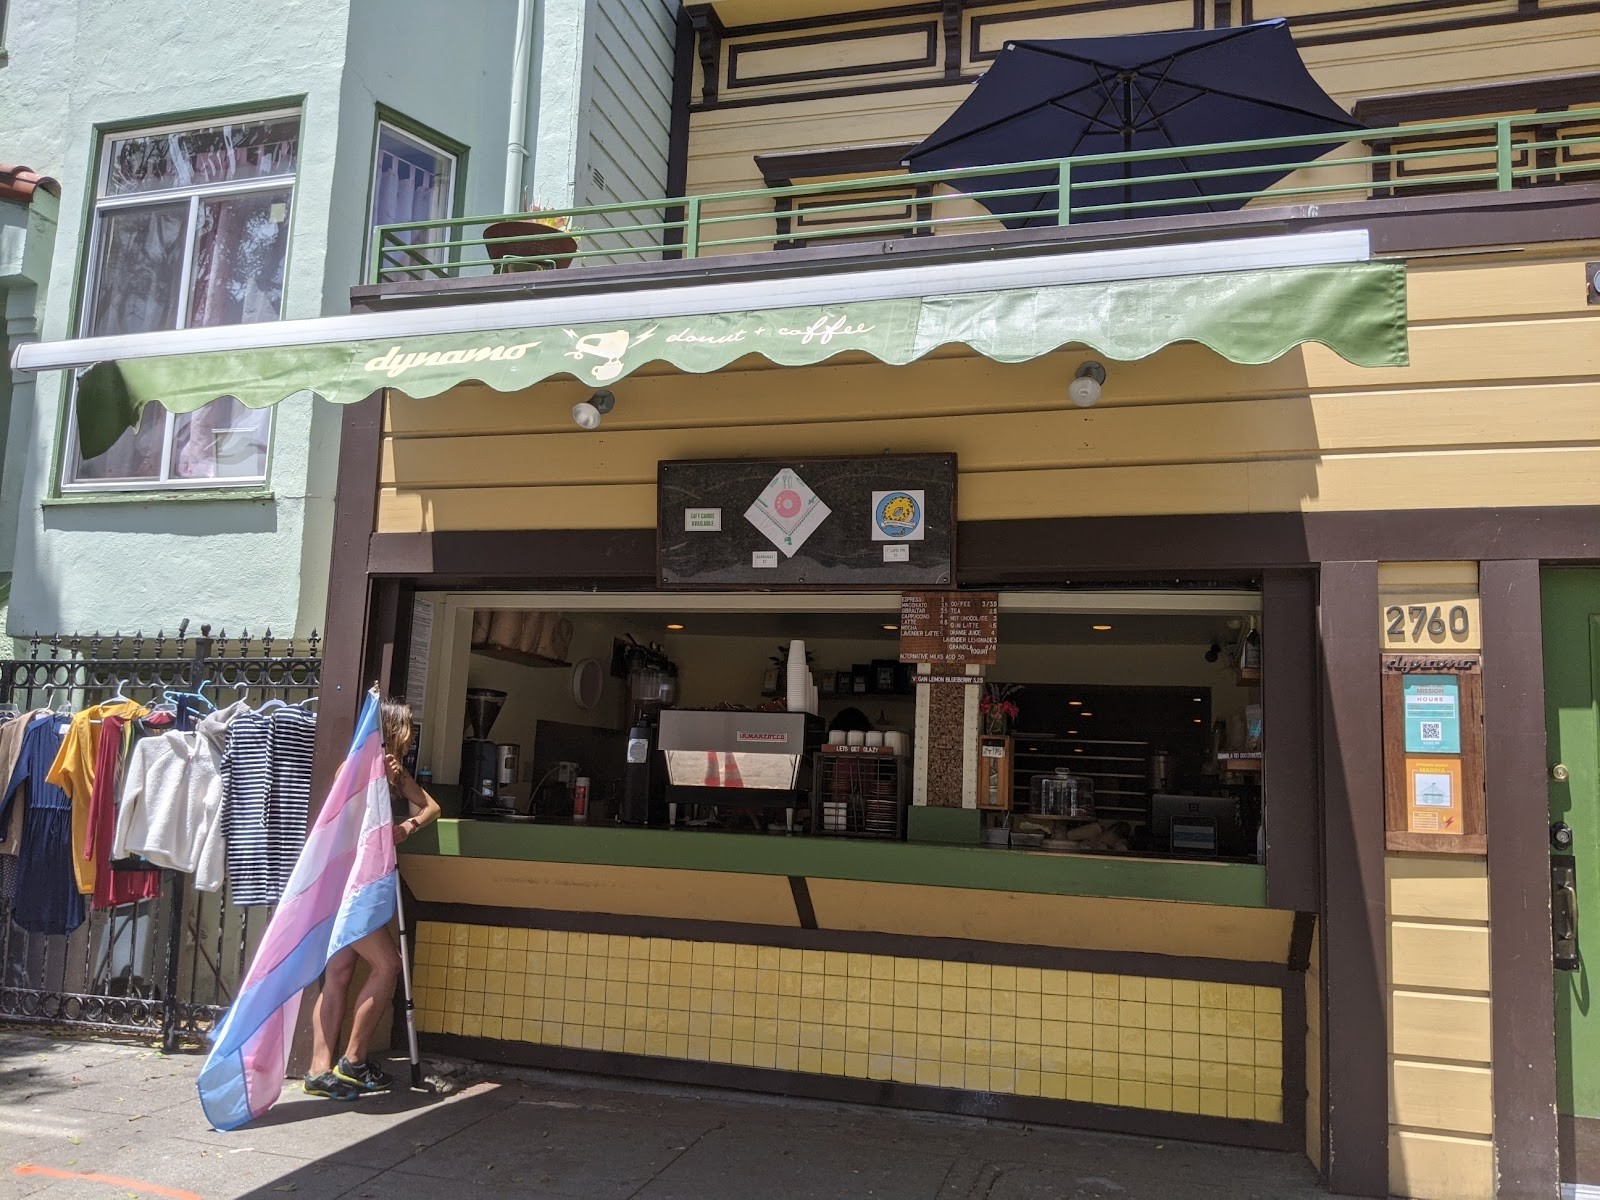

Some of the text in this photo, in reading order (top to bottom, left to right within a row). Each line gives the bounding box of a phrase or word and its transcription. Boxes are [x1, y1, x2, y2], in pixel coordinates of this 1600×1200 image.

[666, 328, 747, 344] donut
[779, 314, 876, 344] coffee
[364, 341, 542, 378] dynamo
[1386, 605, 1468, 635] 2760
[1386, 656, 1476, 673] dynamo
